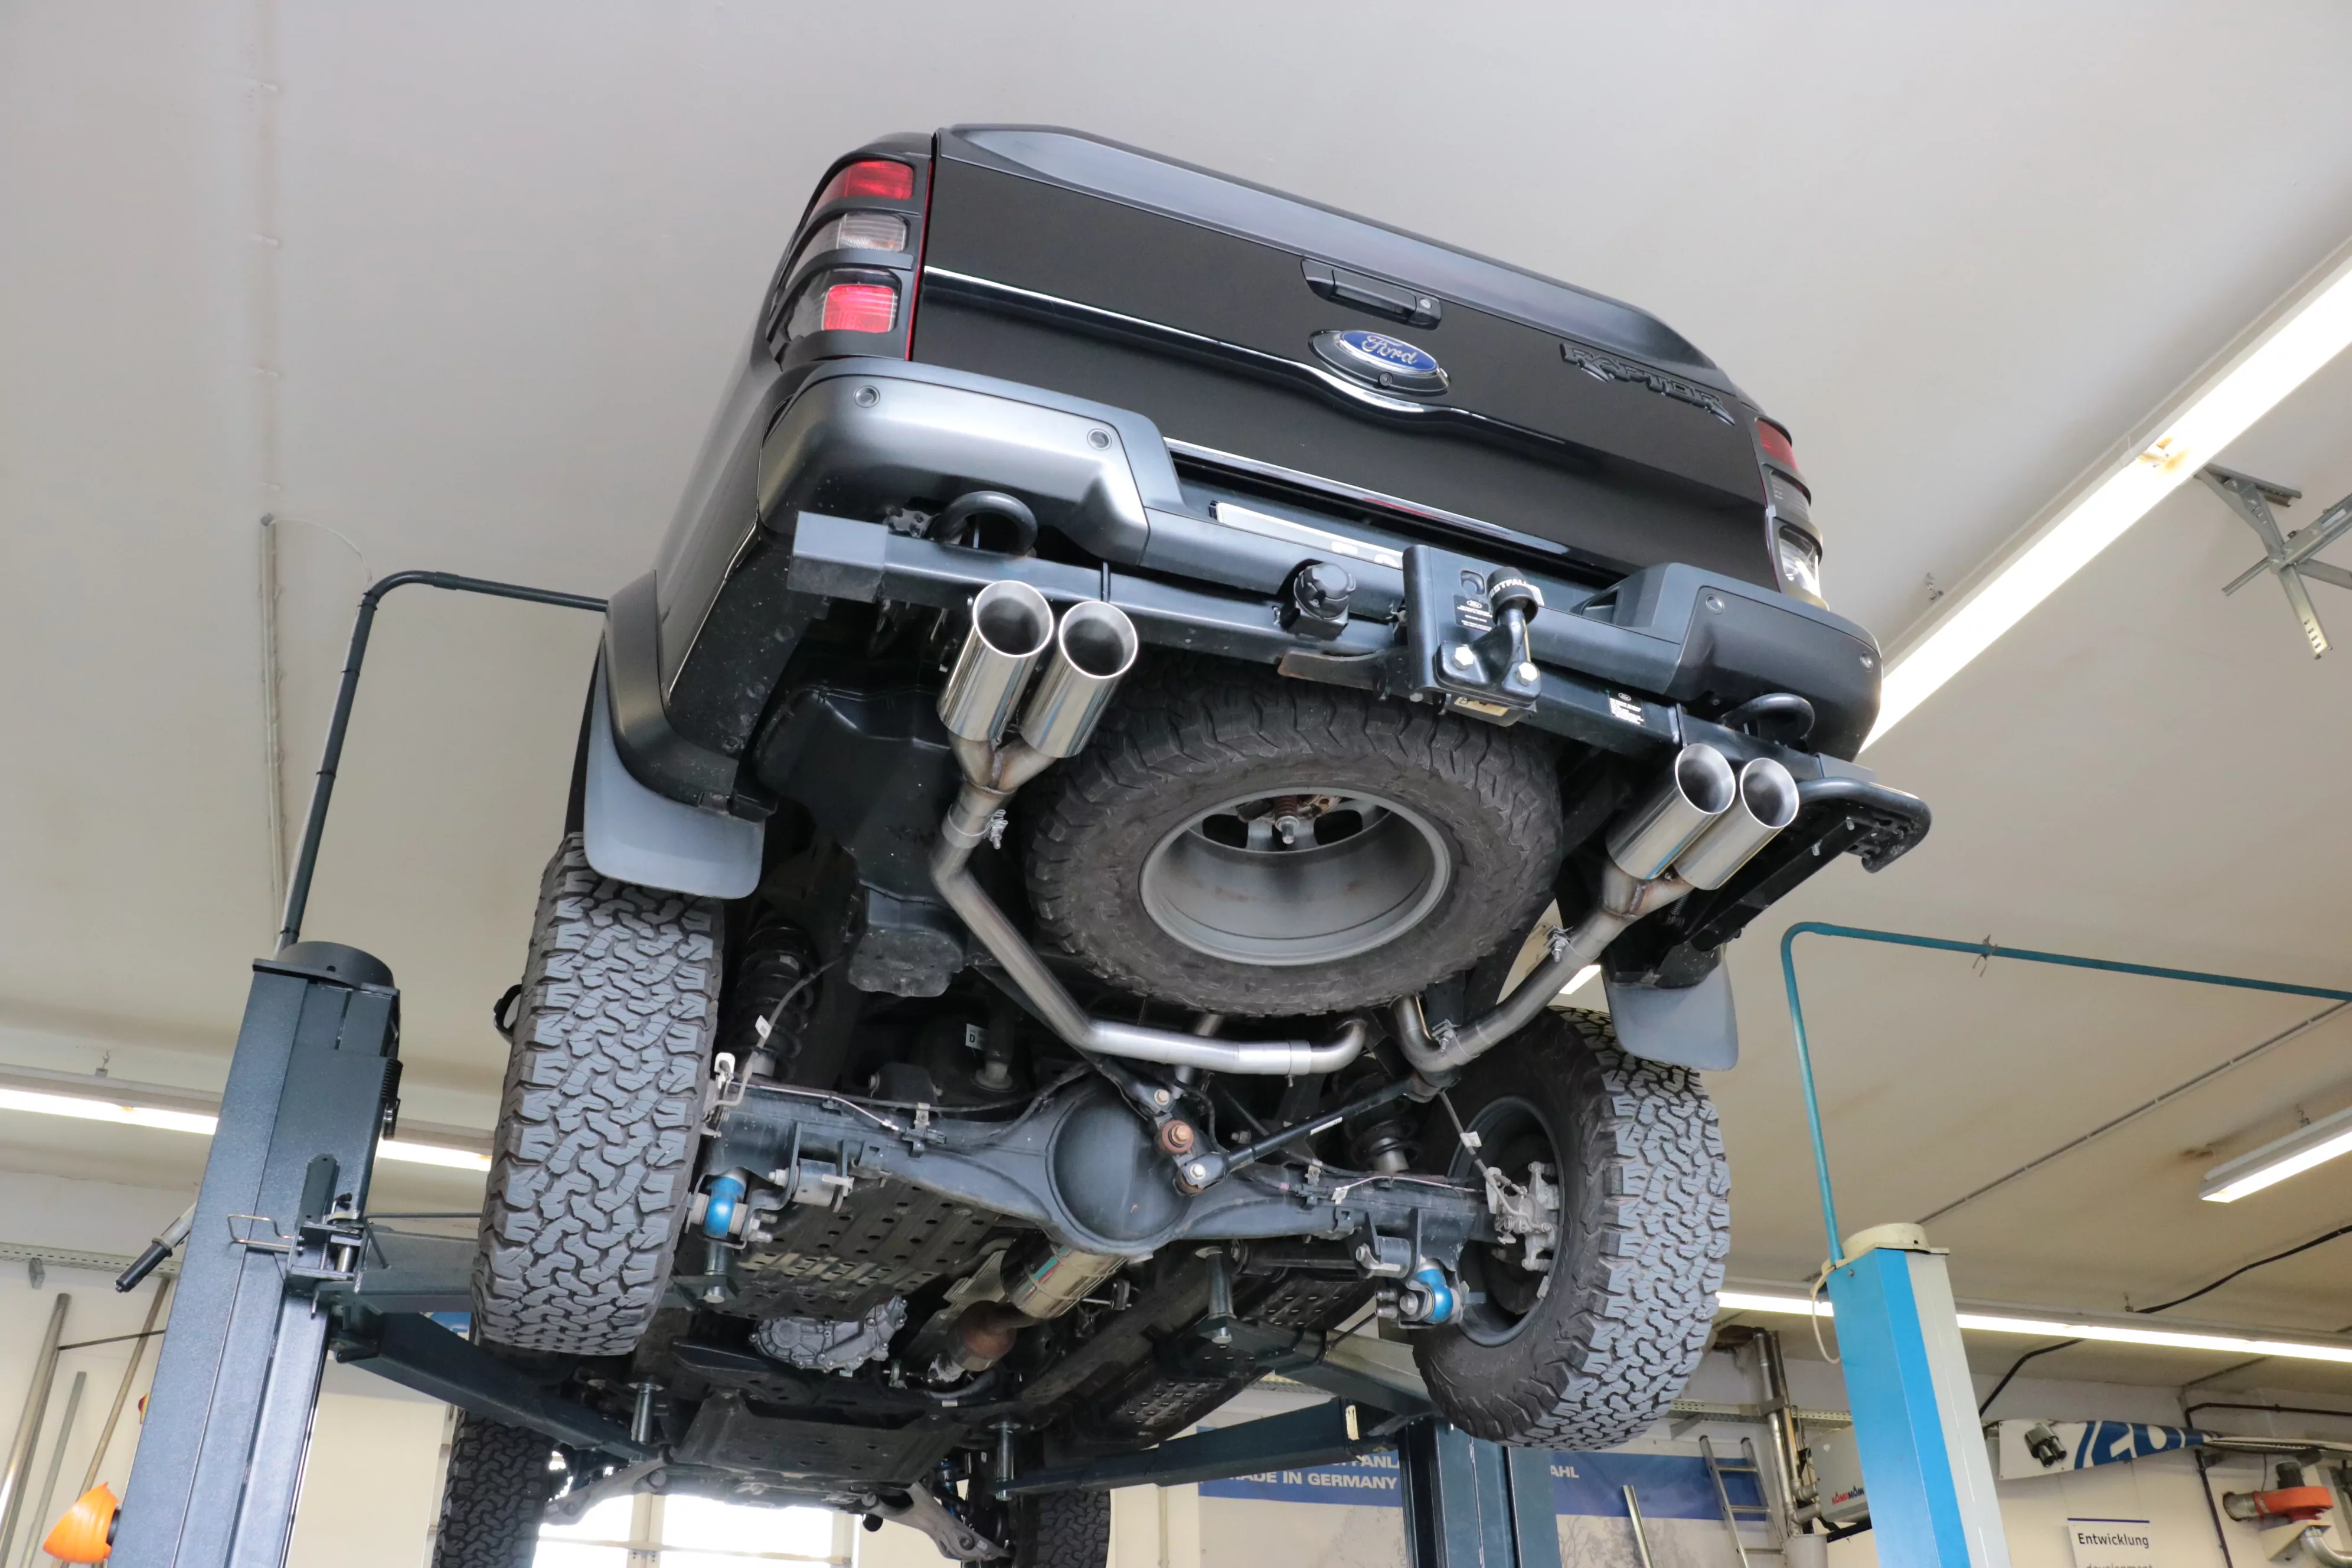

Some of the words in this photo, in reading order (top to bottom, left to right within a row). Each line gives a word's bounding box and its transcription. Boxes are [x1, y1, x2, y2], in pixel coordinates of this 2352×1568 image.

[1361, 335, 1417, 364] Ford
[1560, 343, 1736, 426] RAPTOR
[1229, 1471, 1278, 1484] ADE
[1283, 1471, 1302, 1485] IN
[1307, 1472, 1398, 1490] GERMANY
[2077, 1533, 2150, 1549] Entwicklung
